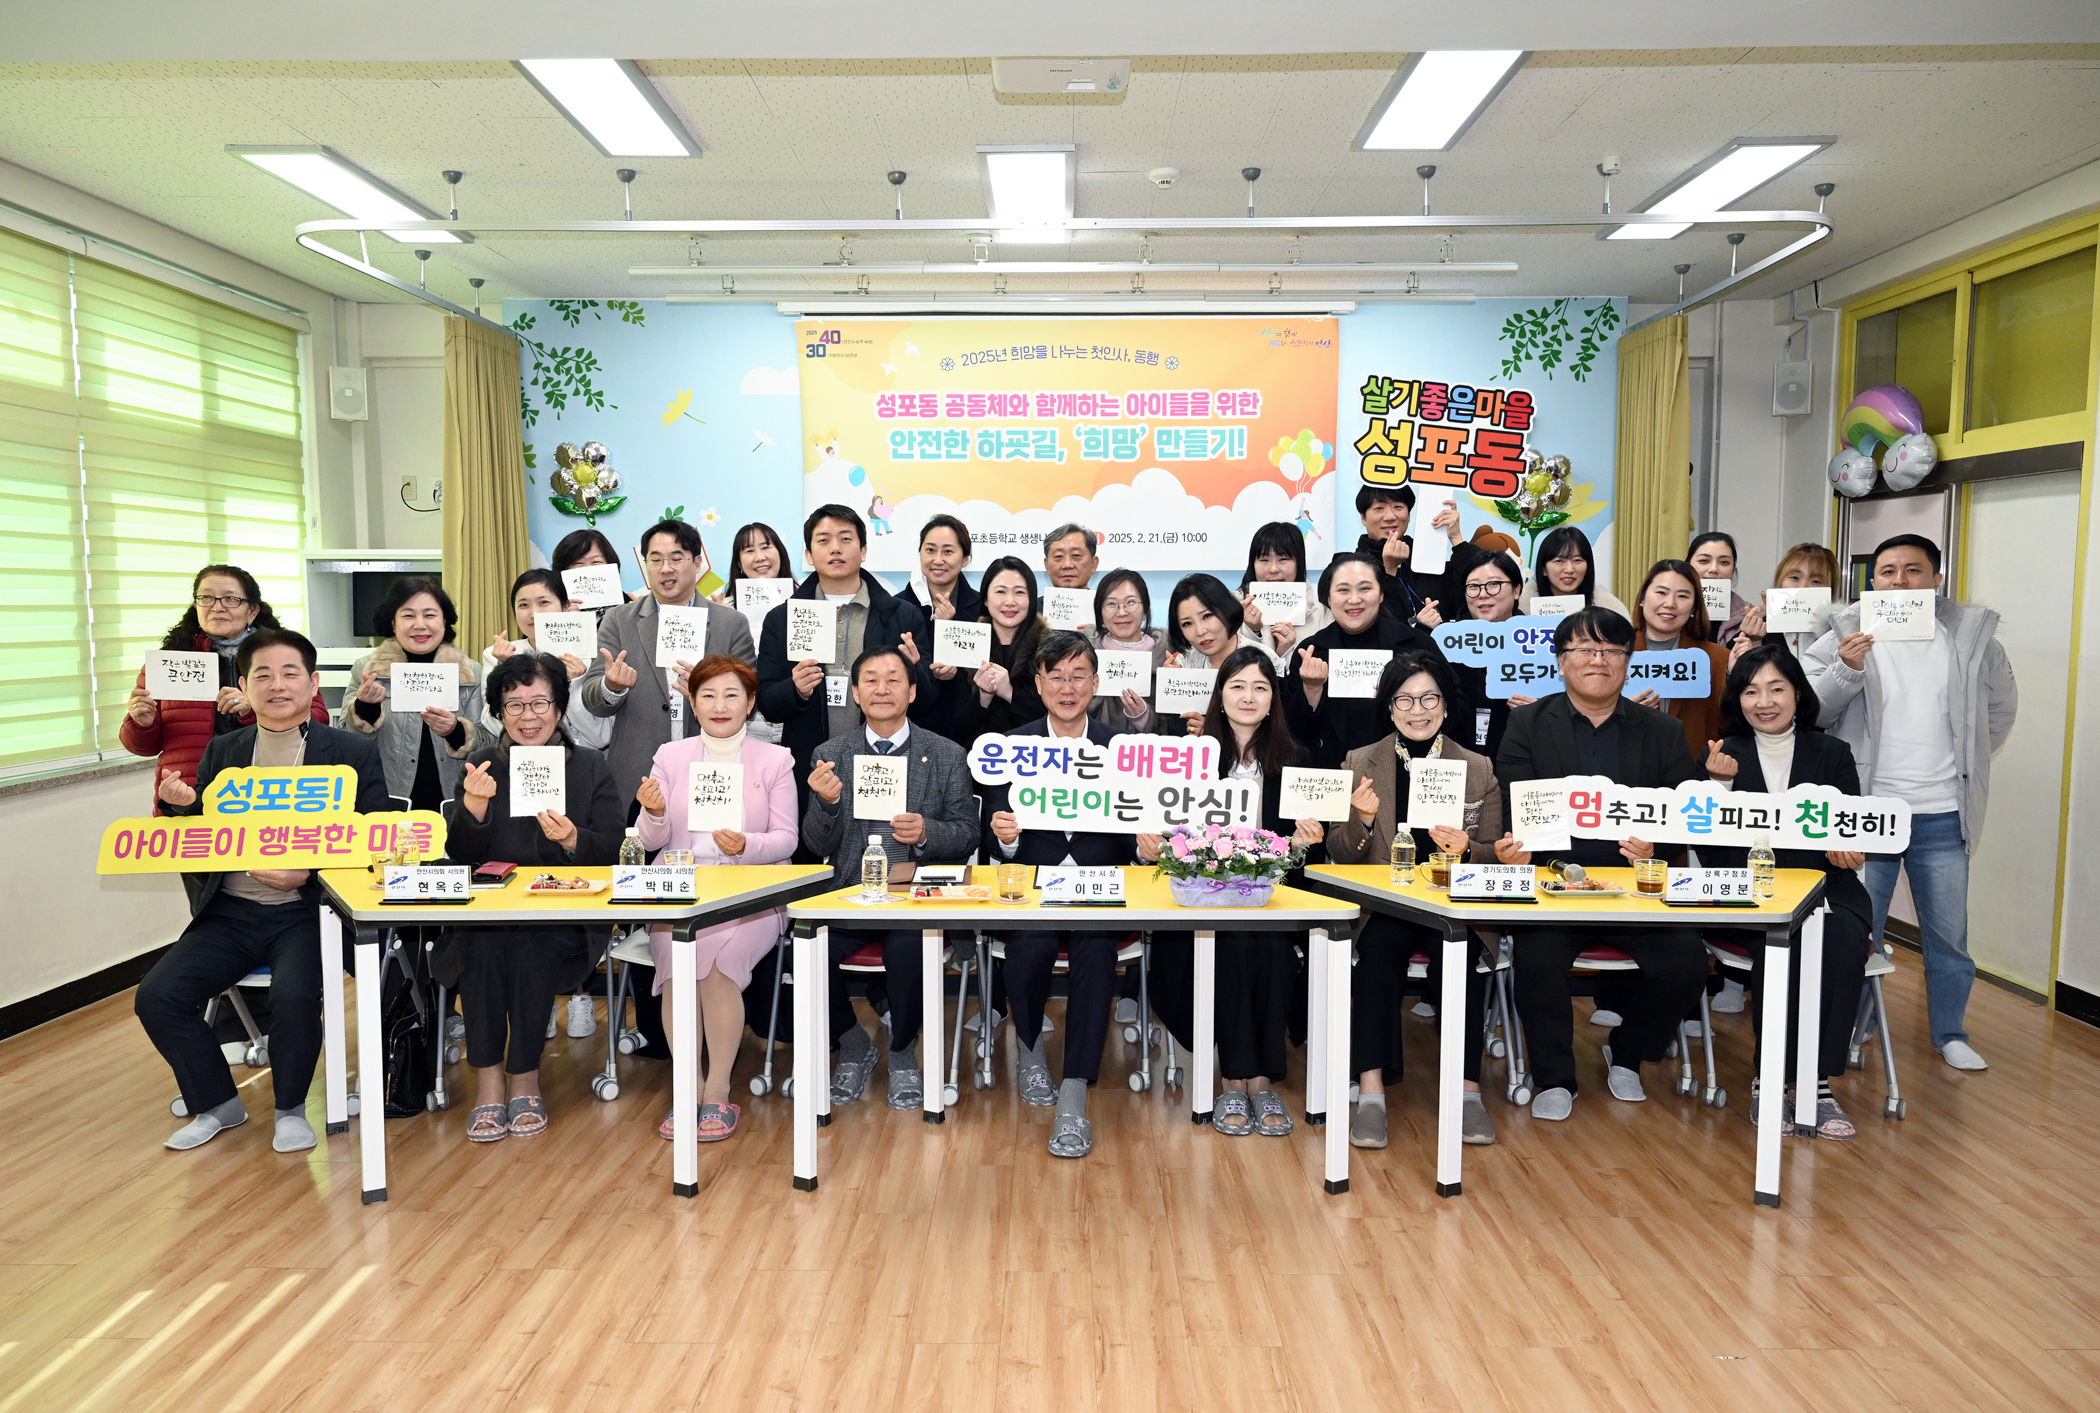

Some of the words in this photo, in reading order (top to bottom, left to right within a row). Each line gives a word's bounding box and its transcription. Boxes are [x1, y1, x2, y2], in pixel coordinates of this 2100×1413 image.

[819, 330, 841, 345] 40
[806, 344, 826, 358] 30
[962, 348, 1007, 366] 2025년
[1010, 345, 1048, 361] 희망을
[1051, 345, 1088, 359] 나누는
[1091, 345, 1131, 363] 첫인사,
[1134, 349, 1160, 366] 동행
[876, 393, 938, 418] 성포동
[945, 393, 1029, 417] 공동체와
[1035, 393, 1119, 417] 함께하는
[1126, 392, 1210, 416] 아이들을
[1216, 391, 1260, 416] 위한
[889, 428, 970, 459] 안전한
[977, 428, 1066, 462] 하굣길,
[1156, 428, 1245, 459] 만들기!
[1355, 417, 1527, 498] 성포동
[1109, 533, 1135, 543] 2025.
[1137, 533, 1146, 543] 2.
[1182, 533, 1208, 543] 10:00
[1443, 632, 1505, 655] 어린이
[1500, 662, 1558, 684] 모두가
[1629, 661, 1697, 682] 지켜요!
[978, 743, 1104, 780] 운전자는
[1117, 744, 1210, 781] 배려!
[216, 776, 344, 814] 성포동!
[1018, 786, 1144, 819] 어린이는
[1157, 786, 1250, 828] 안심!
[1568, 790, 1668, 828] 멈추고!
[1680, 795, 1781, 835] 살피고!
[1794, 798, 1897, 839] 천천히!
[114, 826, 246, 860] 아이들이
[258, 823, 358, 856] 행복한
[368, 822, 433, 855] 마을
[641, 867, 672, 875] 안산시의회
[675, 867, 694, 875] 시의장
[1482, 866, 1516, 874] 경기도의회
[1519, 866, 1533, 874] 의원
